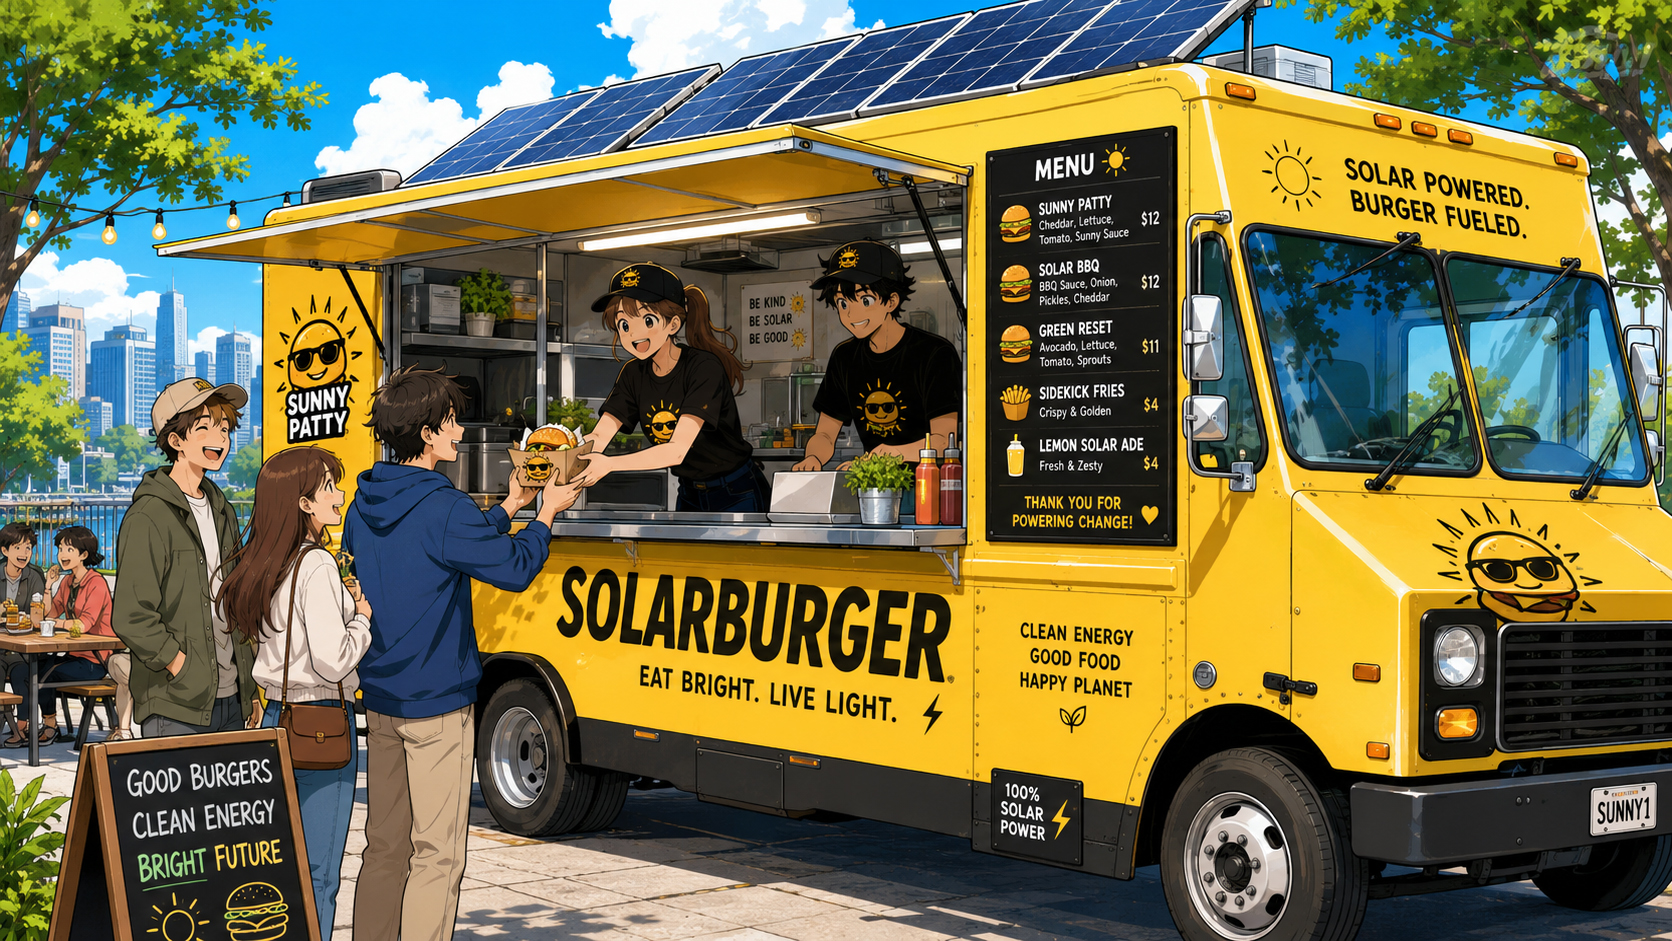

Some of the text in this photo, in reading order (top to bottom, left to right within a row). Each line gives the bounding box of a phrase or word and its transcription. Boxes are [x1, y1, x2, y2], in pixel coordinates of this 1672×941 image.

[1035, 152, 1094, 181] MENU
[1344, 158, 1529, 210] SOLAR POWERED.
[1039, 195, 1112, 216] SUNNY PATTY
[1350, 189, 1529, 239] BURGER FUELED.
[1039, 215, 1114, 230] Cheddar, Lettuce,
[1141, 211, 1160, 227] $12
[1039, 228, 1129, 245] Tomato, Sunny Sauce
[1039, 259, 1099, 276] SOLAR BBQ
[1039, 276, 1118, 292] BBQ Sauce, Onion,
[1141, 274, 1160, 290] $12
[749, 296, 786, 310] BE KIND
[1039, 291, 1110, 306] Pickles, Cheddar
[749, 313, 792, 327] BE SOLAR
[1039, 320, 1113, 337] GREEN RESET
[749, 331, 788, 345] BE GOOD
[1039, 340, 1117, 352] Avocado, Lettuce,
[1142, 338, 1159, 354] $11
[1039, 354, 1112, 368] Tomato, Sprouts
[1039, 383, 1125, 400] SIDEKICK FRIES
[288, 385, 349, 416] SUNNY
[1144, 397, 1159, 412] $4
[1039, 405, 1111, 420] Crispy & Golden
[290, 410, 347, 440] PATTY
[1040, 437, 1144, 452] LEMON SOLAR ADE
[1040, 460, 1103, 474] Fresh & Zesty
[1144, 456, 1158, 471] $4
[1024, 496, 1121, 510] THANK YOU FOR
[1012, 514, 1133, 529] POWERING CHANGE!
[556, 565, 952, 683] SOLARBURGER
[1020, 622, 1134, 646] CLEAN ENERGY
[1030, 647, 1121, 671] GOOD FOOD
[1020, 671, 1132, 698] HAPPY PLANET
[640, 665, 897, 723] EAT BRIGHT. LIVE LIGHT.
[127, 759, 273, 797] GOOD BURGERS
[1005, 783, 1040, 802] 100%
[133, 798, 274, 839] CLEAN ENERGY
[1001, 801, 1044, 822] SOLAR
[1597, 797, 1650, 825] SUNNY1
[1001, 819, 1045, 841] POWER
[137, 839, 283, 883] BRIGHT FUTURE
